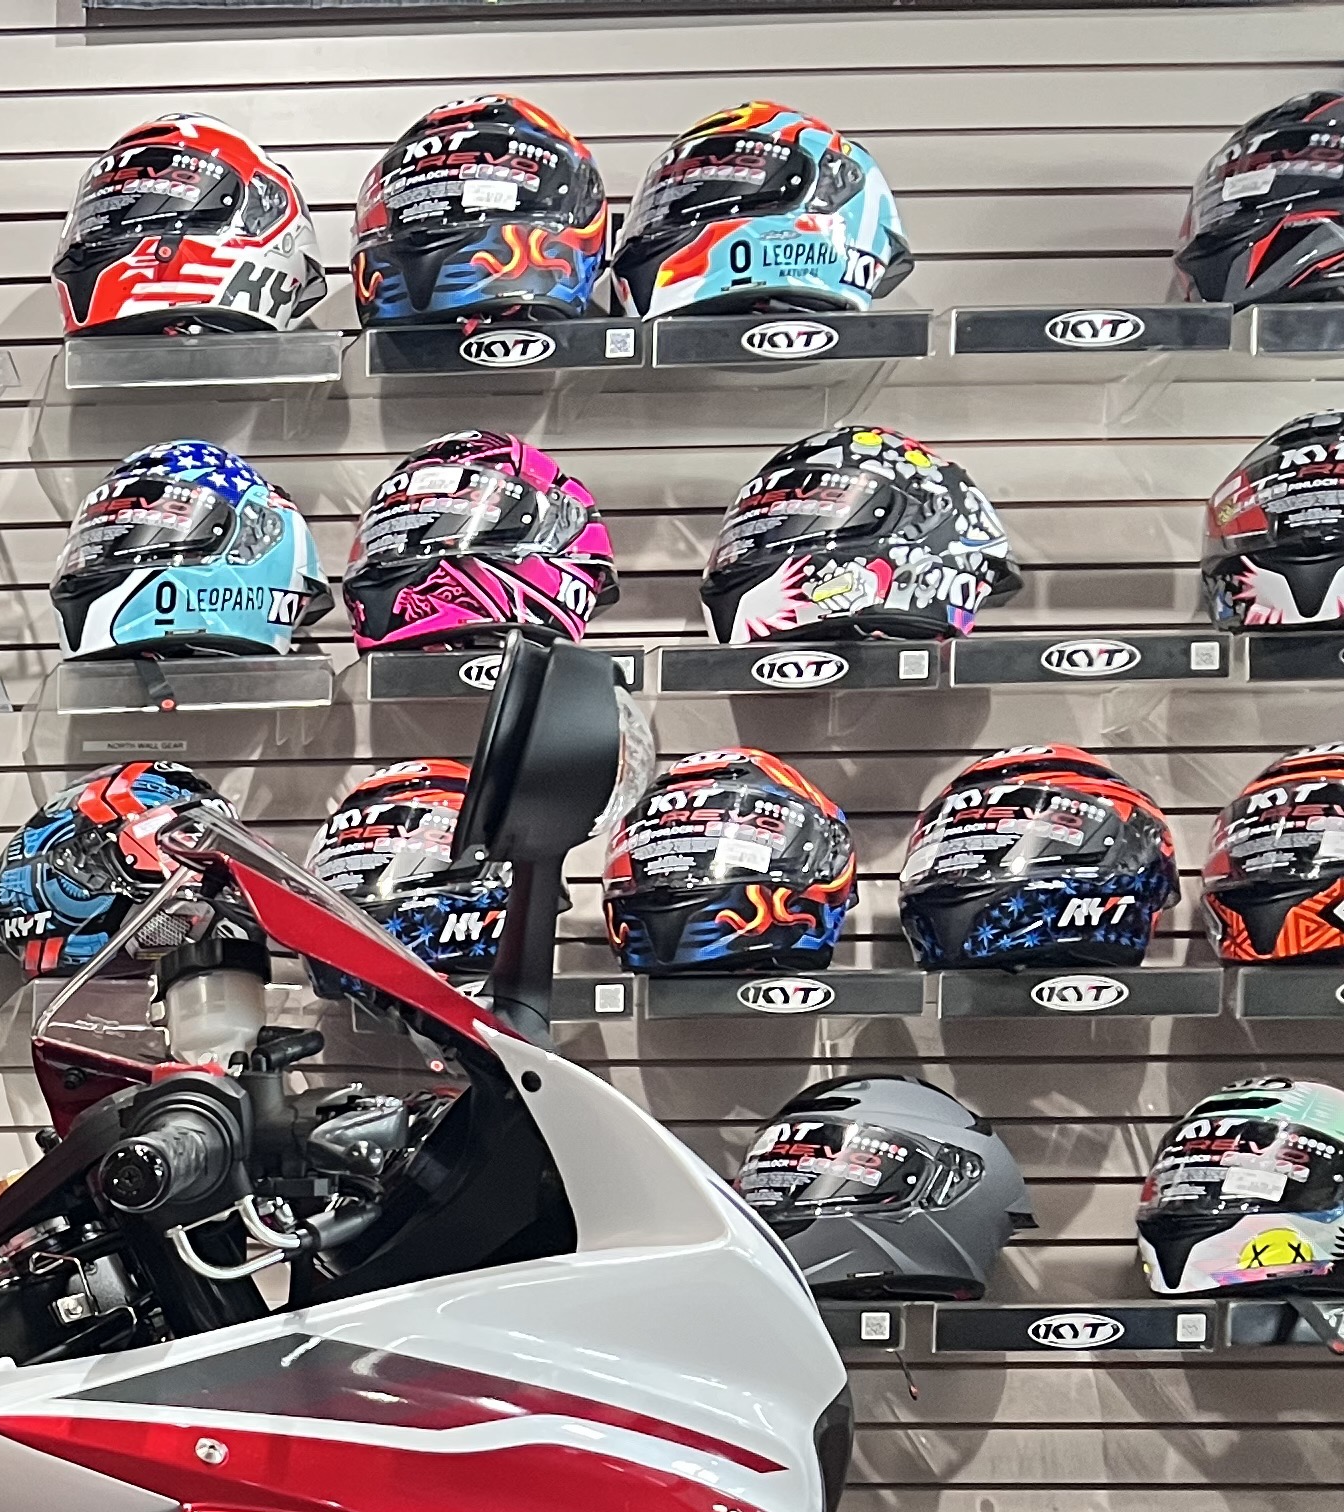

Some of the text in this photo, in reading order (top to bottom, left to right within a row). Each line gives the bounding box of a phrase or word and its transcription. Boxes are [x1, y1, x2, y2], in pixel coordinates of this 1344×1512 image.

[403, 130, 480, 163] KYT
[762, 242, 839, 270] LEOPARD
[1060, 318, 1130, 339] KYT
[475, 338, 539, 357] KYT
[756, 330, 822, 349] KYT
[185, 586, 265, 613] LEOPARD
[767, 659, 834, 679] KYT
[1056, 649, 1125, 668] KYT
[647, 787, 726, 817] KYT
[941, 784, 1022, 815] KYT
[1057, 895, 1136, 927] KYT
[4, 909, 53, 940] KYT
[753, 986, 820, 1004] KYT
[1045, 985, 1115, 1003] KYT
[1049, 1322, 1112, 1342] KYT
